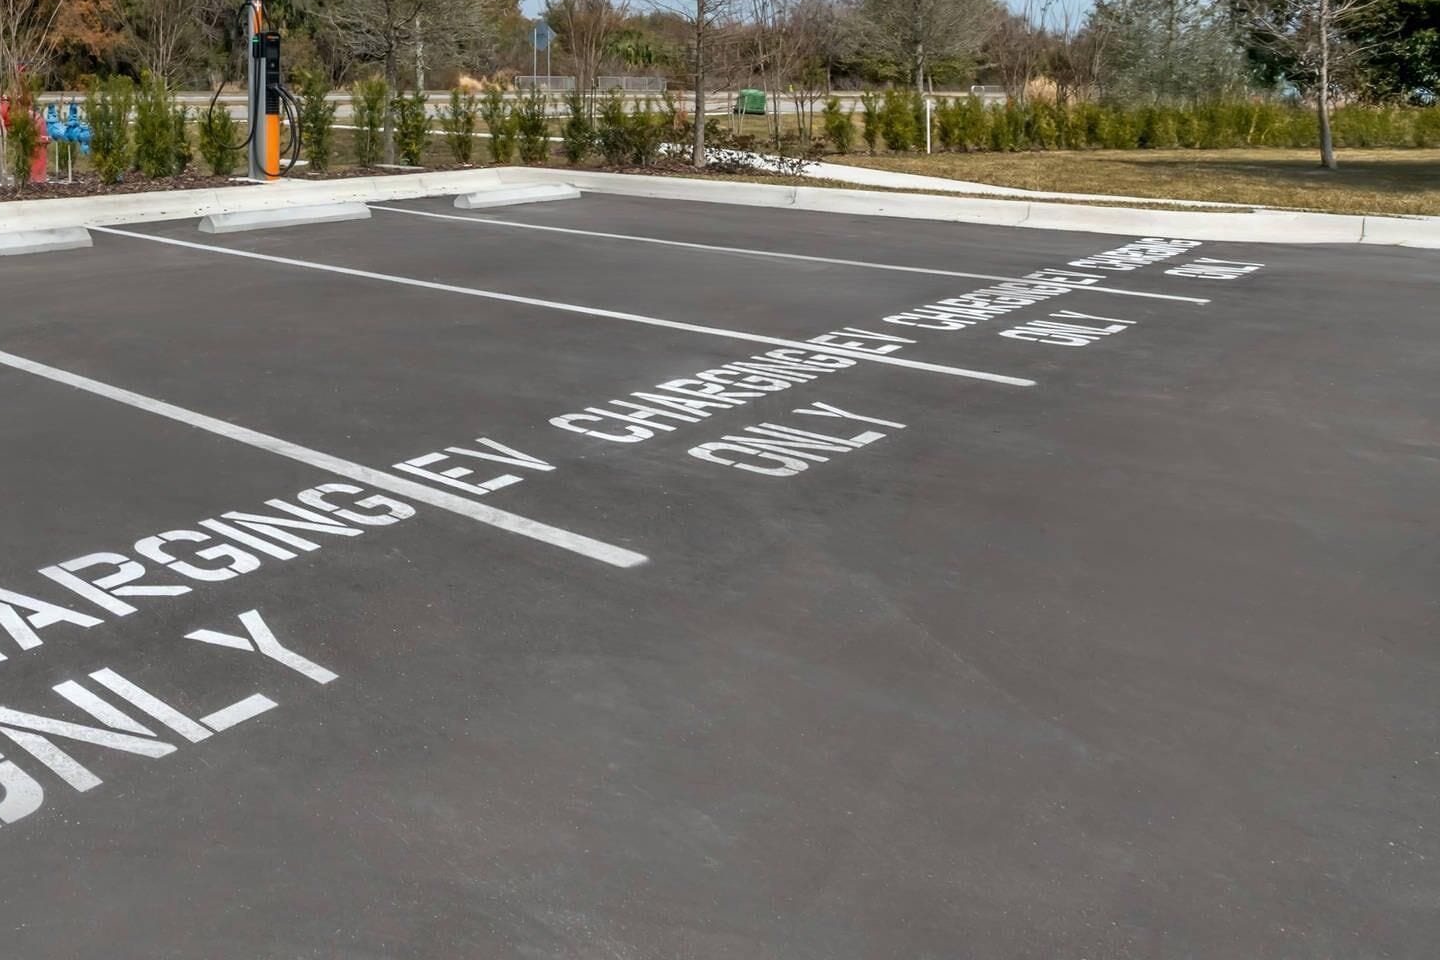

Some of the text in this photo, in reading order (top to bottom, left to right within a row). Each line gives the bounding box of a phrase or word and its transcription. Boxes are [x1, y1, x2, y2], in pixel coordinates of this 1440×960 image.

[1022, 268, 1107, 286] EV
[1164, 257, 1265, 280] ONLY
[805, 281, 1072, 355] EV CHARGING
[998, 310, 1137, 346] ONLY
[392, 348, 857, 495] EV CHARGING
[687, 401, 907, 476] ONLY
